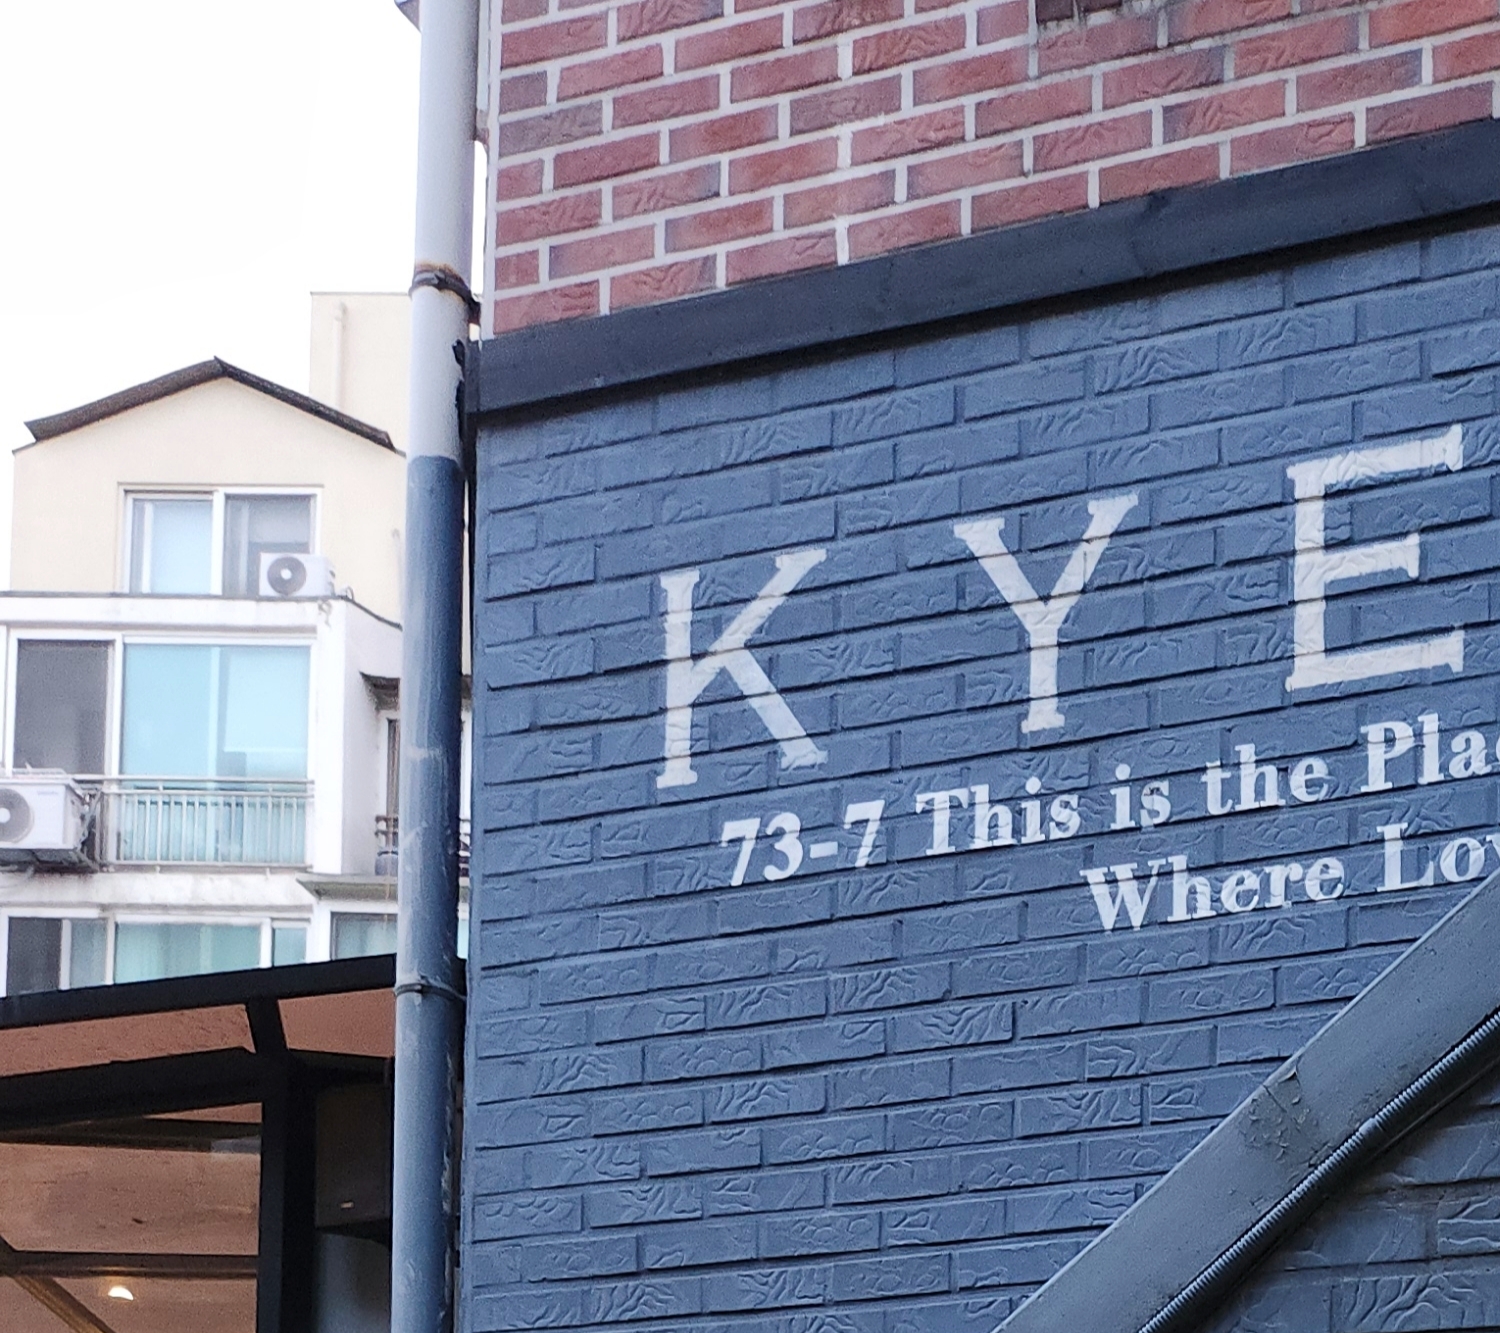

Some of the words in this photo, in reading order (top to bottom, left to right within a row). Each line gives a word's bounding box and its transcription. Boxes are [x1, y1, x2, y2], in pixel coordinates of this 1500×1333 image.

[719, 799, 885, 887] 73-7
[915, 776, 1081, 856] This
[1109, 763, 1172, 831] is
[1200, 743, 1331, 817] the
[1079, 854, 1346, 932] Where
